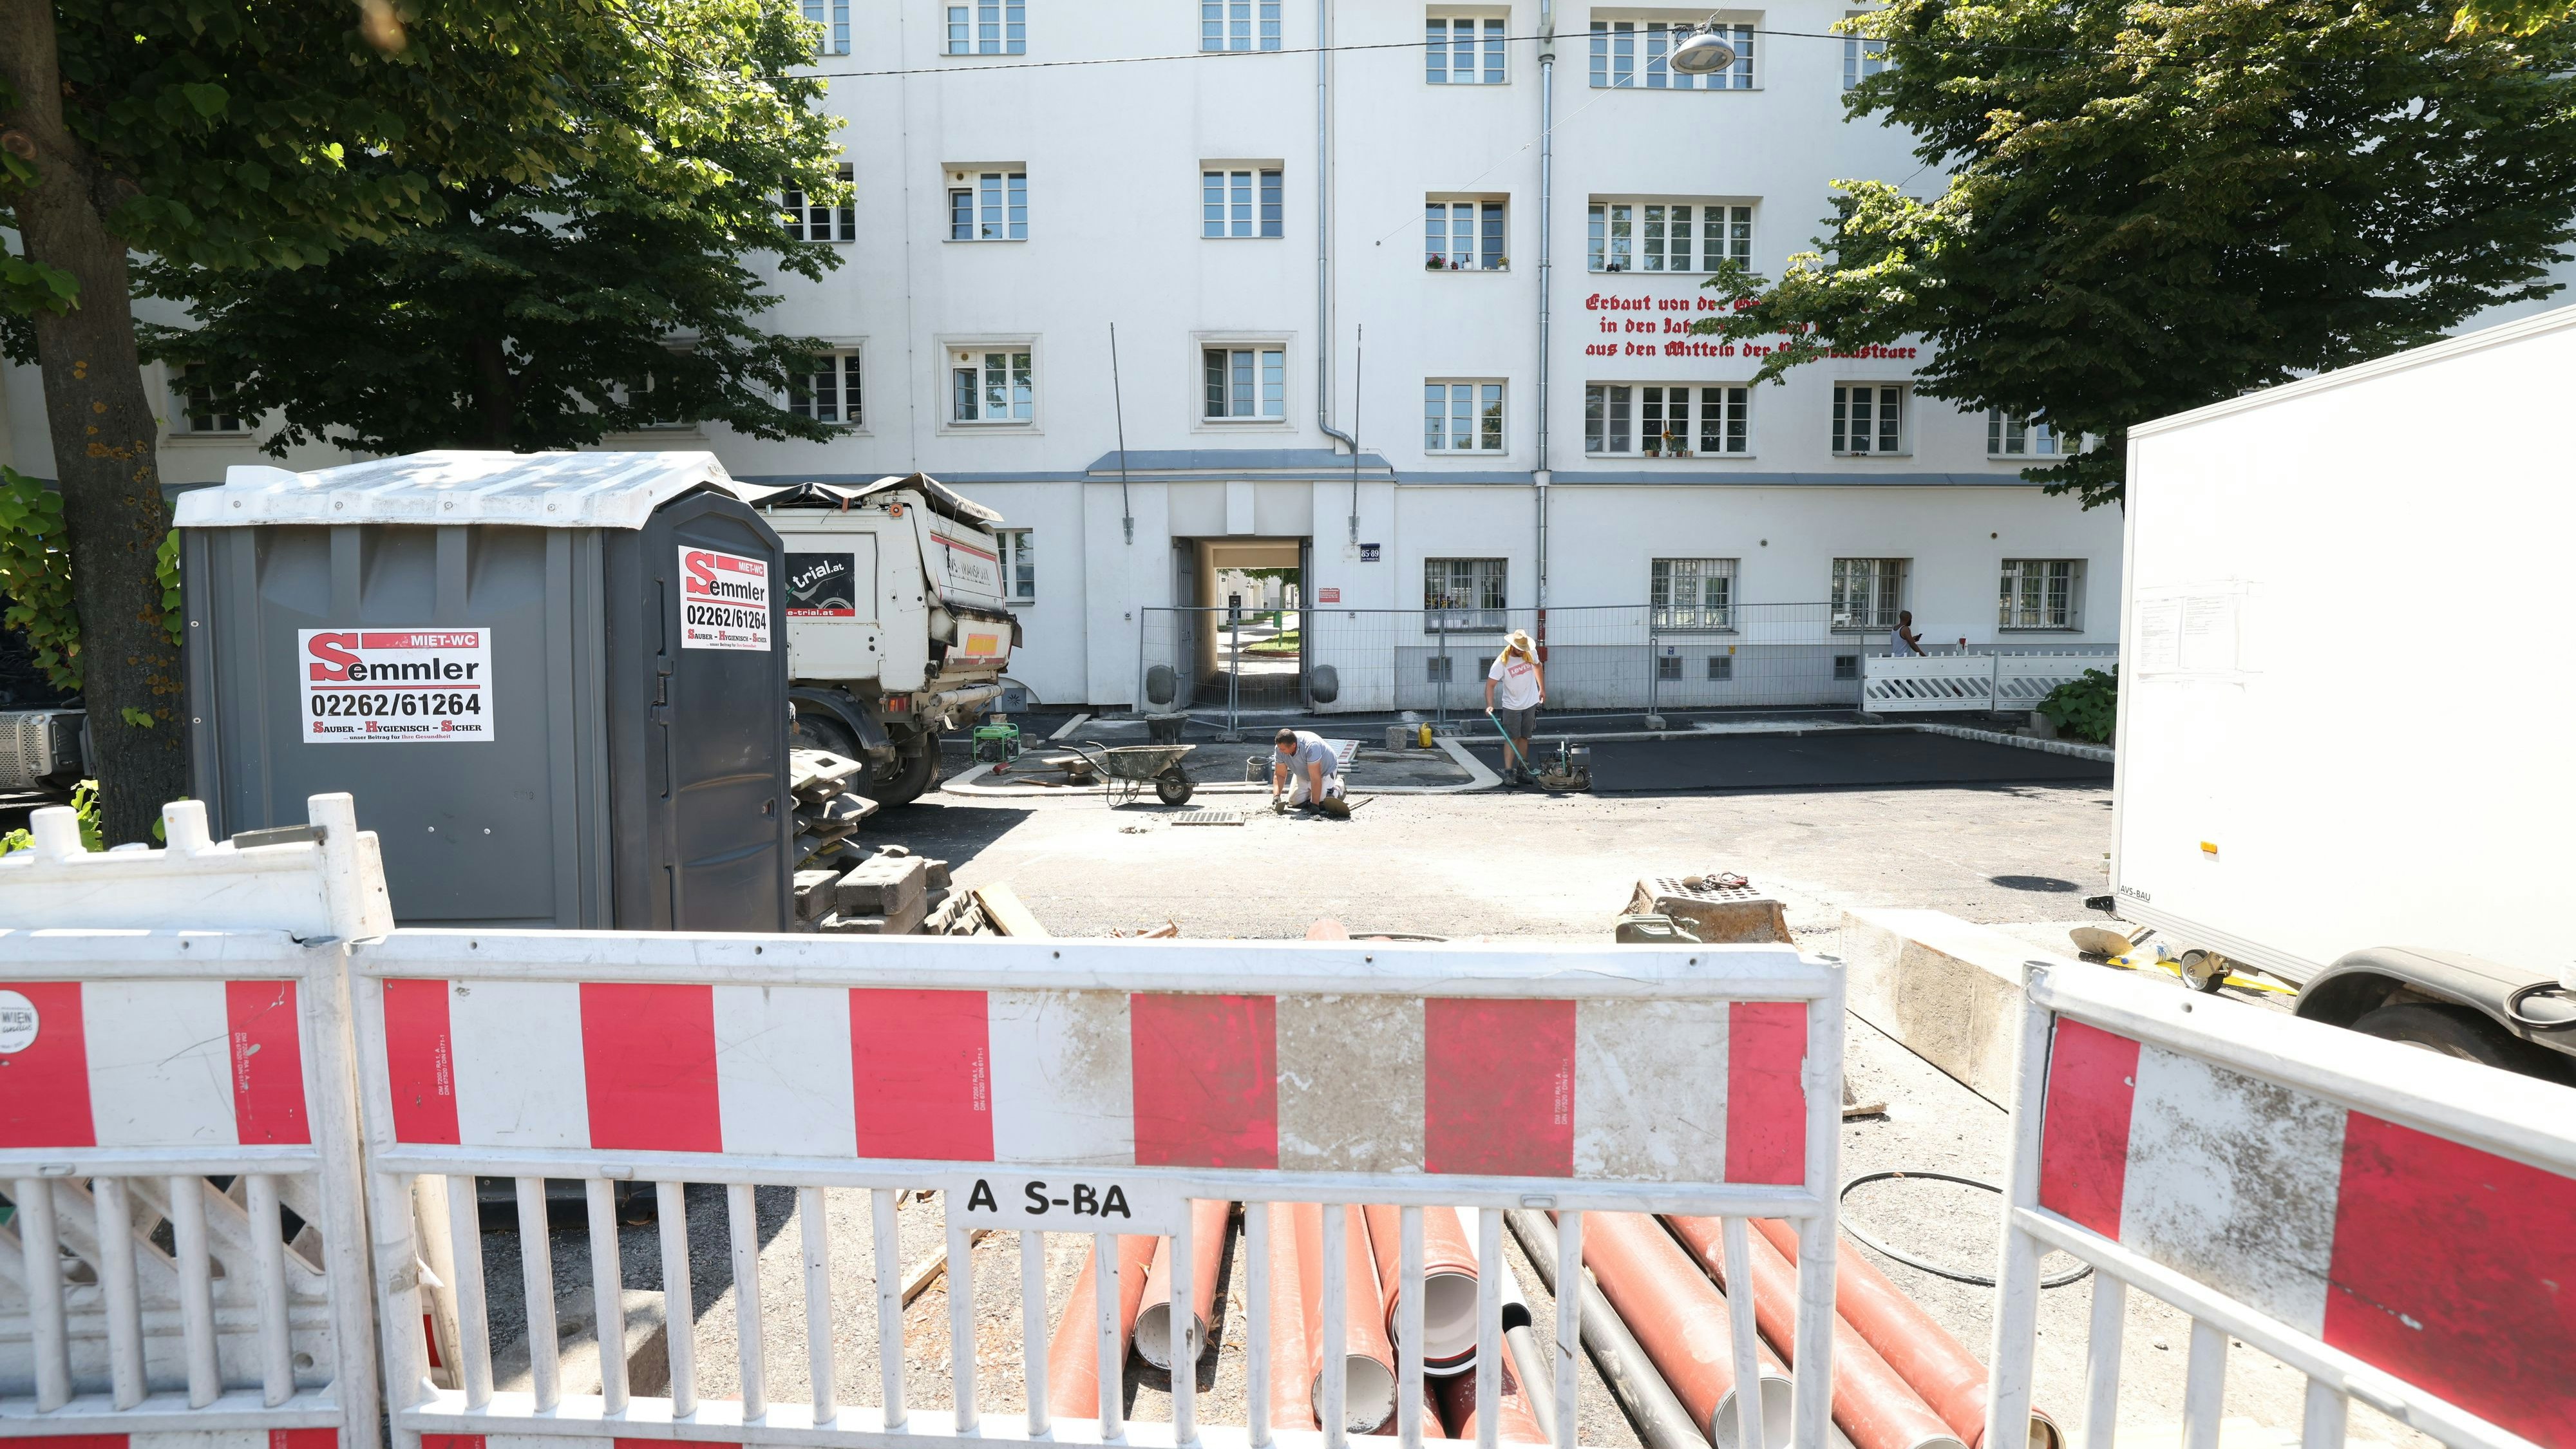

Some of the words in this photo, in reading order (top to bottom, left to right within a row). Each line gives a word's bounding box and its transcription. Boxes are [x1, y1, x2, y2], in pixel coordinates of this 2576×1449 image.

[1586, 294, 1651, 310] Erbaut
[1697, 296, 1726, 312] der
[1600, 316, 1618, 333] in
[1625, 318, 1656, 333] den
[1586, 344, 1618, 357] aus
[1625, 341, 1656, 356] den
[1664, 341, 1734, 357] Mitteln
[1743, 343, 1771, 357] der
[739, 562, 763, 574] MIET-WC
[685, 551, 765, 601] Semmler
[687, 605, 766, 630] 02262/61264
[410, 634, 475, 646] MIET-WC
[688, 629, 713, 639] SAUBER
[719, 630, 748, 641] HYGIENISCH
[752, 633, 767, 643] SICHER
[308, 632, 479, 681] Semmler
[312, 693, 481, 717] 02262/61264
[313, 721, 354, 734] SAUBER
[365, 721, 430, 733] HYGIENISCH
[441, 719, 482, 732] SICHER
[2120, 885, 2151, 901] AVS-BAU
[3, 1012, 32, 1023] WIEN
[242, 1032, 247, 1042] DM
[243, 1059, 249, 1068] RA
[436, 1060, 441, 1068] RA
[972, 1074, 978, 1083] RA
[439, 1086, 444, 1095] DM
[1555, 1086, 1561, 1095] RA
[974, 1101, 980, 1111] DM
[1555, 1114, 1561, 1124] DM
[967, 1179, 998, 1213] A
[1025, 1180, 1132, 1219] S-BA
